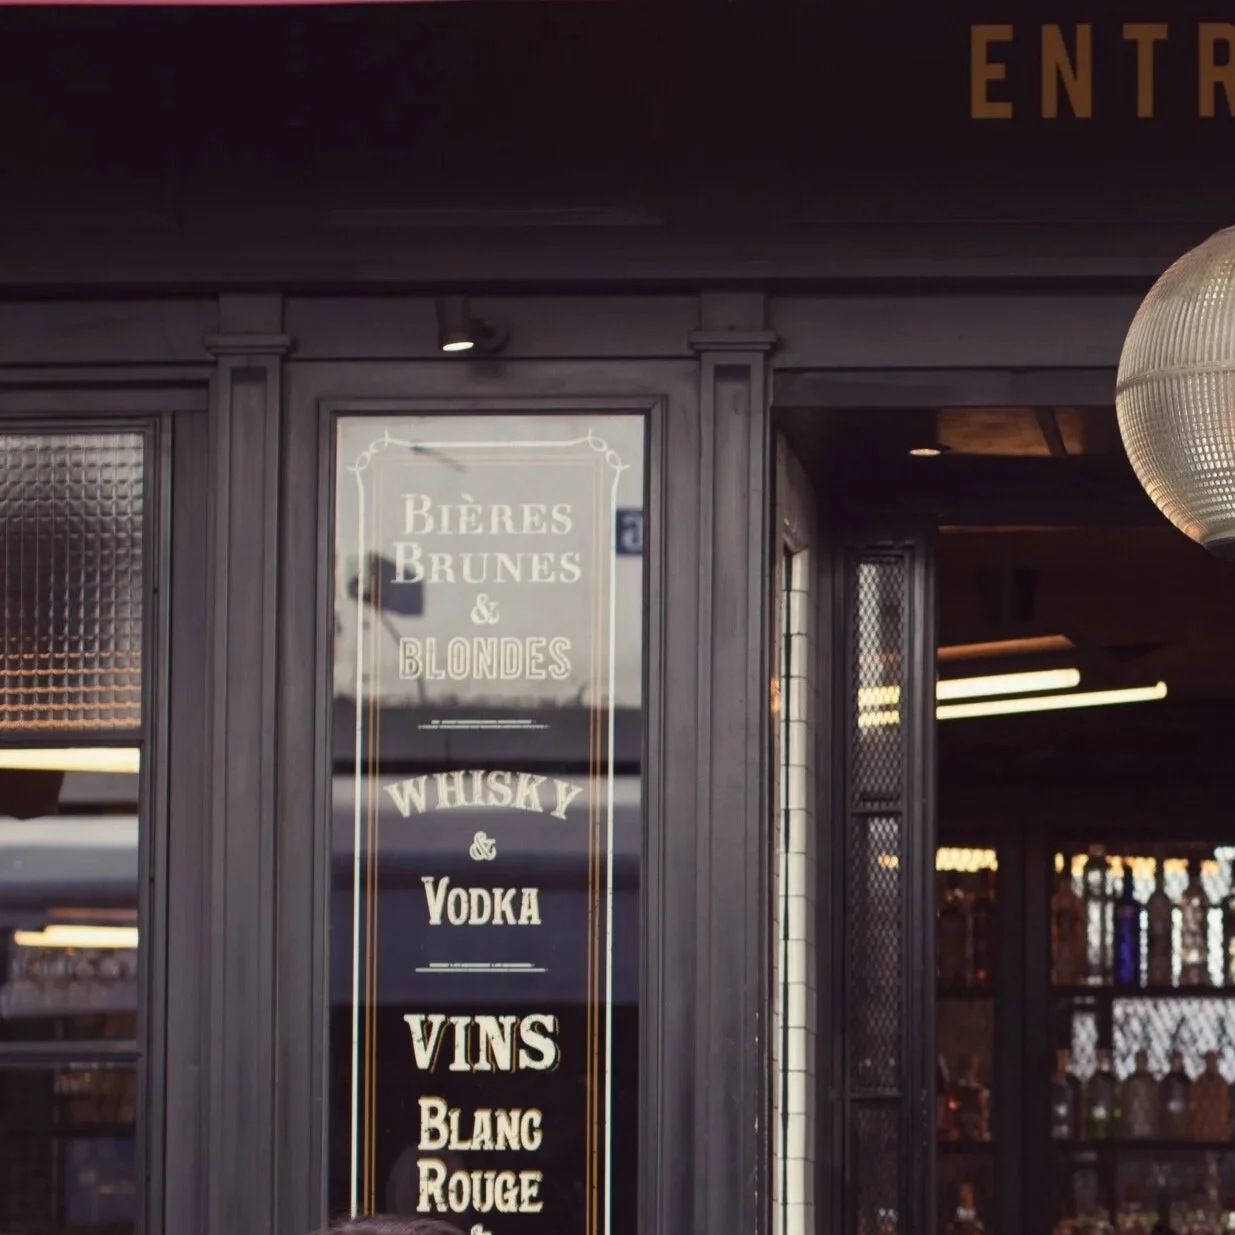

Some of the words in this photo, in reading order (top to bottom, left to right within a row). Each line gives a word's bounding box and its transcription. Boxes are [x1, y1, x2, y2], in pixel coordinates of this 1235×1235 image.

[400, 492, 573, 535] BIÈRES
[390, 541, 582, 584] BRUNES
[470, 593, 500, 625] &
[399, 636, 572, 681] BLONDES
[383, 769, 584, 820] WHISKY
[469, 830, 497, 861] &
[420, 876, 542, 926] VODKA
[403, 1014, 560, 1072] VINS
[417, 1096, 543, 1152] BLANC
[416, 1158, 544, 1214] ROUGE
